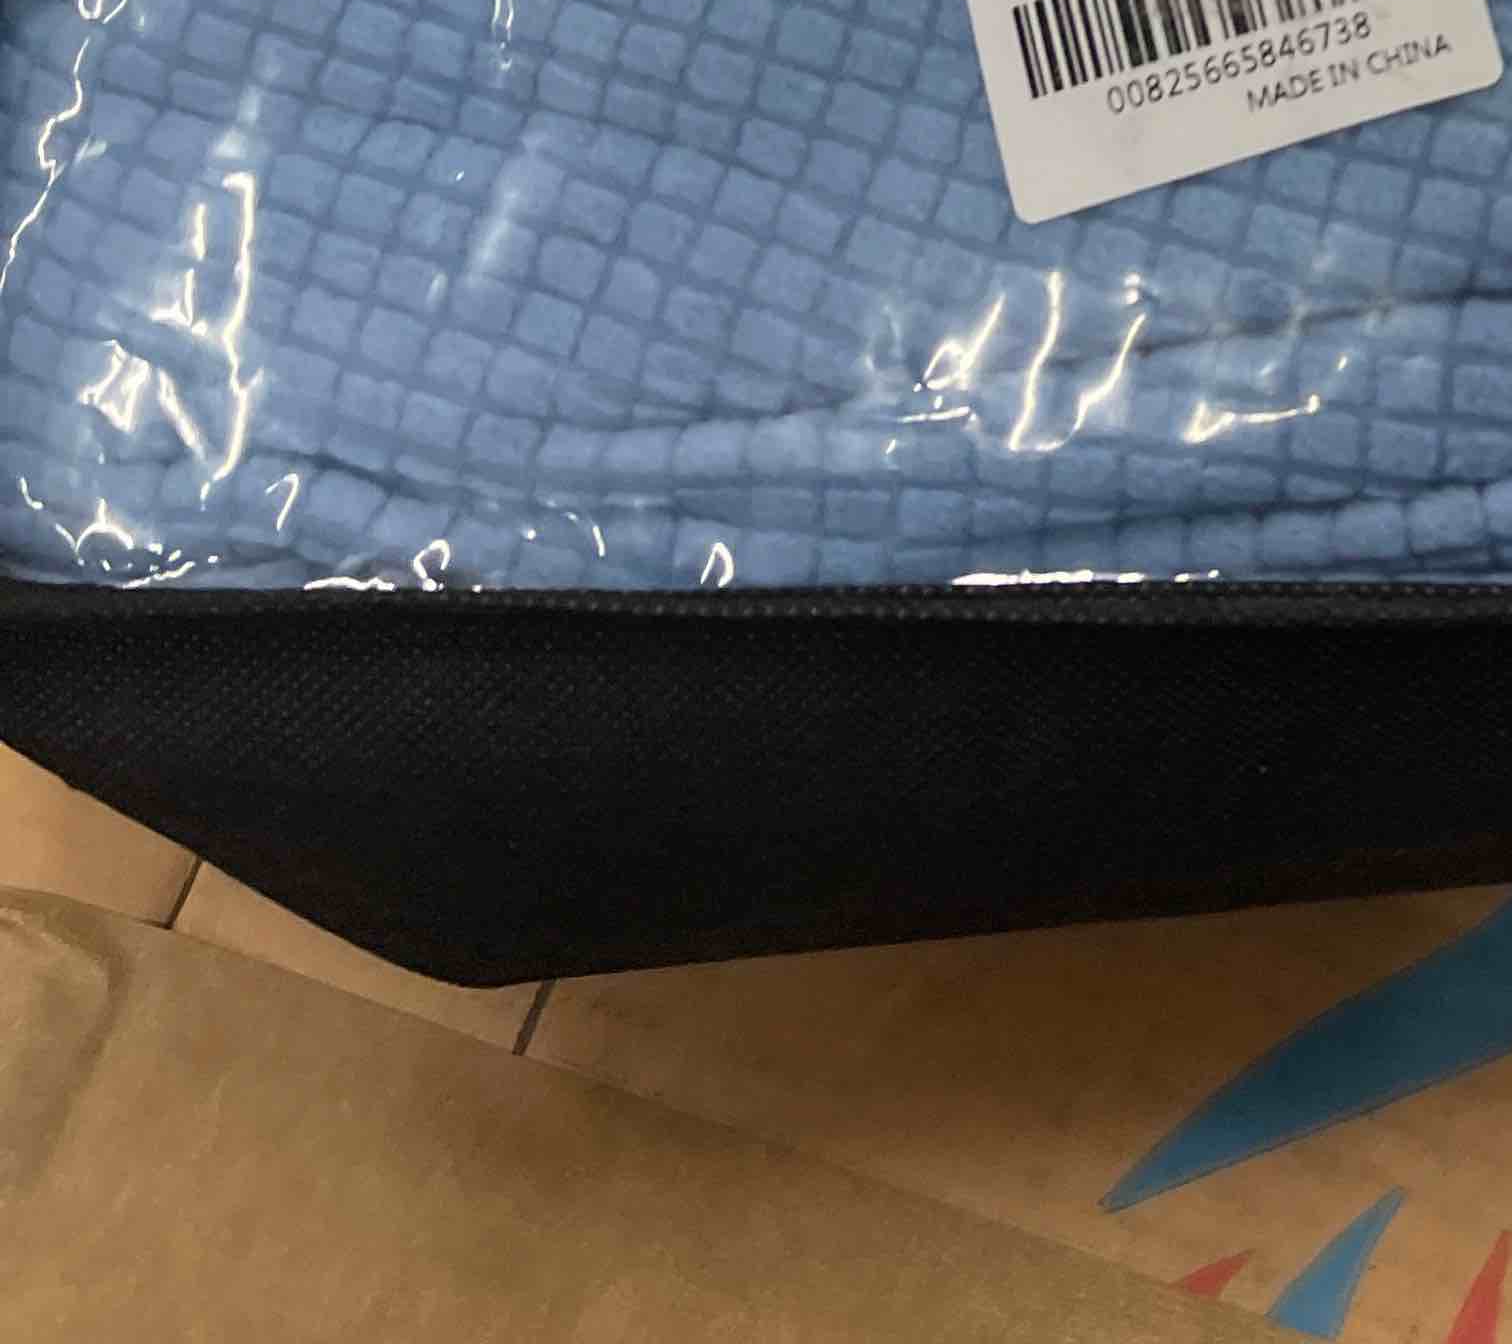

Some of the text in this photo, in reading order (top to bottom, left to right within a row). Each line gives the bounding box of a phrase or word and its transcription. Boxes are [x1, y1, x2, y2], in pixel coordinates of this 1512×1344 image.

[1107, 11, 1373, 114] 00825665846738
[1247, 32, 1453, 113] MADE IN CHINA
